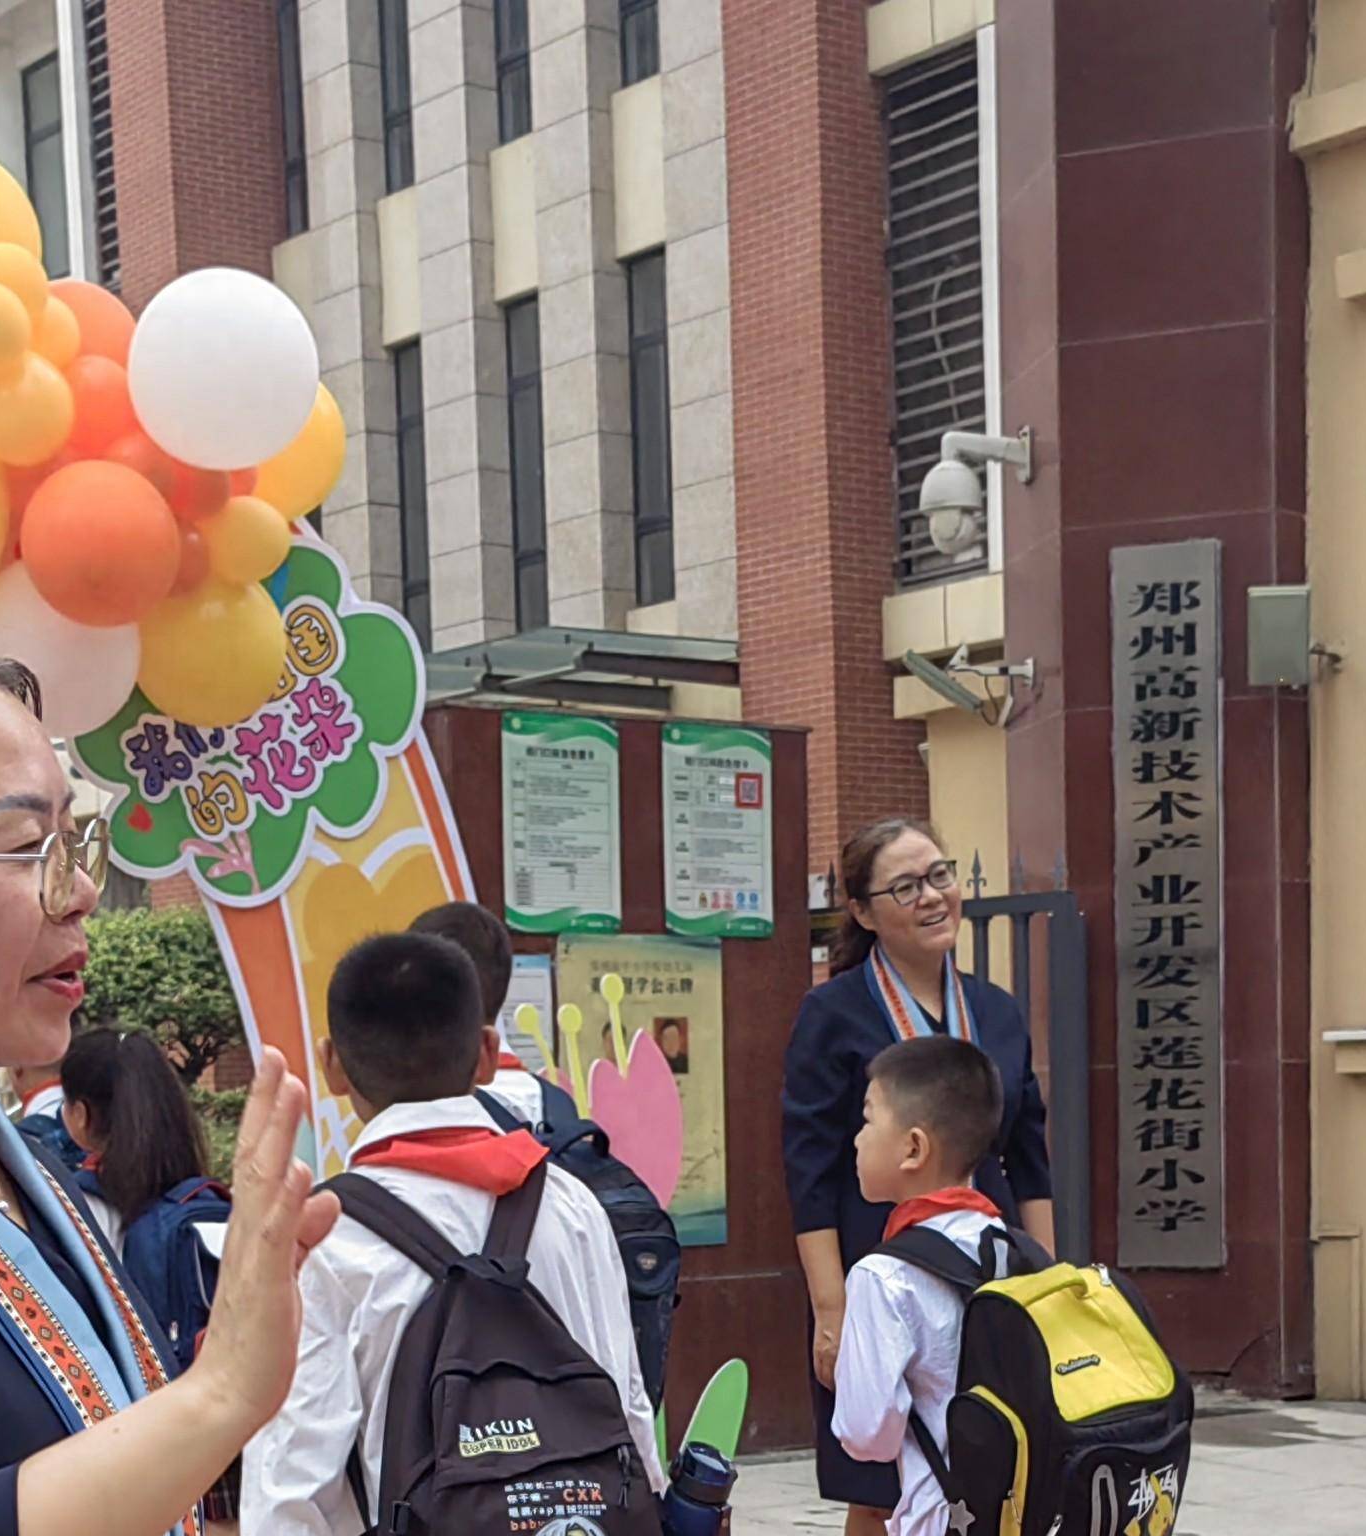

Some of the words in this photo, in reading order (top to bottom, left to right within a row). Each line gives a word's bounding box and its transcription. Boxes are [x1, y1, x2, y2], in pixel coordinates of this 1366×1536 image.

[1129, 579, 1205, 1234] 郑州高新技术产业开发区莲花街小学
[563, 1488, 604, 1502] CXK
